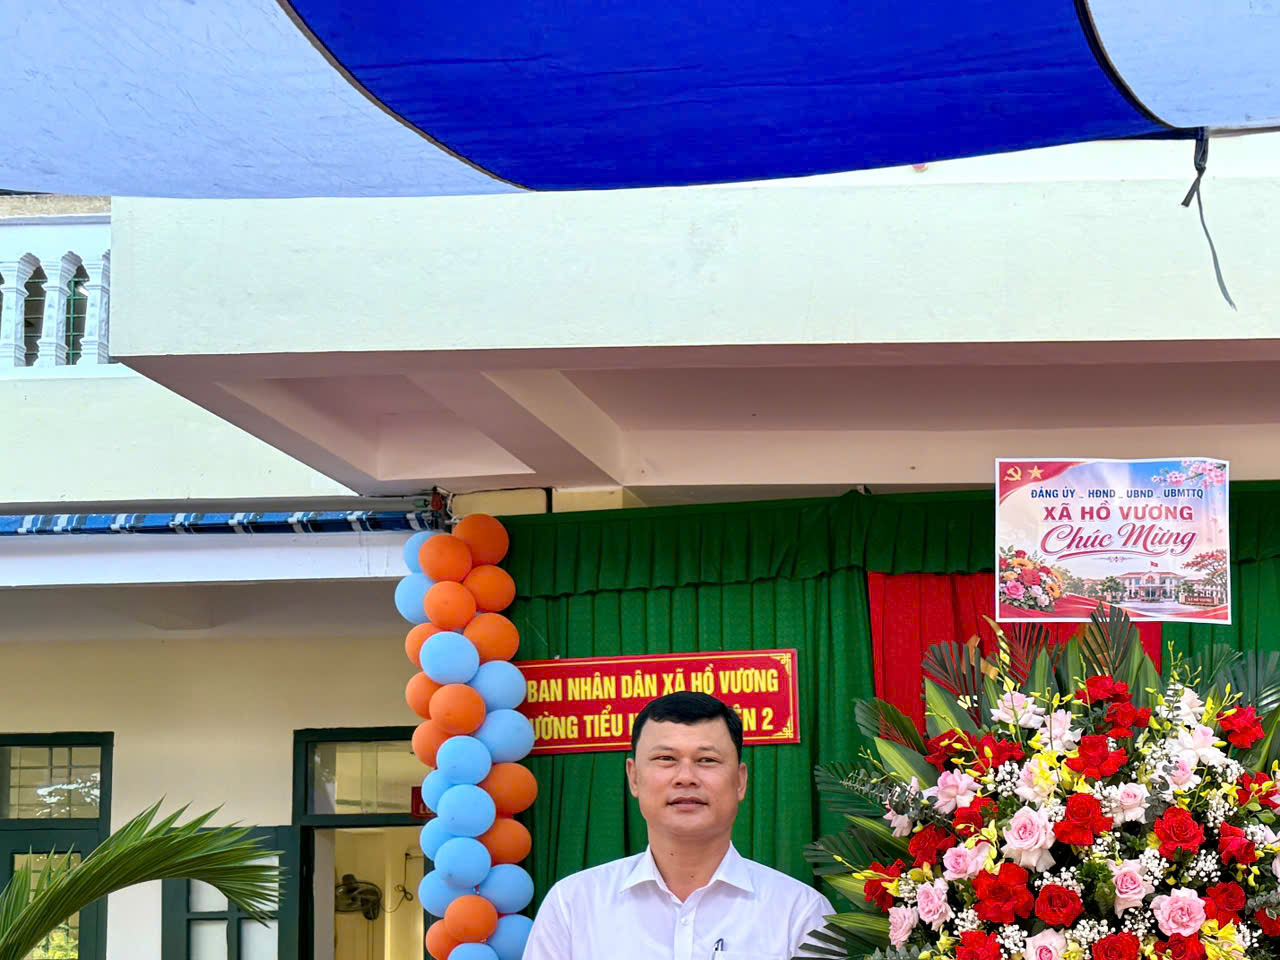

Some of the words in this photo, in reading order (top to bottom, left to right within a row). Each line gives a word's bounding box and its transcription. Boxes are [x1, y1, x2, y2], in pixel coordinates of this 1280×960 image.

[1088, 489, 1116, 498] HĐND
[1127, 489, 1153, 498] UBND
[1164, 488, 1203, 499] UBMTTQ
[1043, 503, 1072, 520] XÃ
[1081, 500, 1110, 520] HỒ
[1119, 504, 1193, 521] VƯƠNG
[1041, 524, 1113, 554] Chúc
[1118, 522, 1198, 556] Mừng
[527, 680, 562, 702] BAN
[567, 672, 617, 701] NHÂN
[621, 671, 657, 698] DÂN
[663, 668, 685, 696] XÃ
[719, 667, 779, 694] VƯƠNG
[530, 711, 578, 740] ƯỜNG
[583, 704, 623, 738] TIỂU
[762, 707, 774, 730] 2
